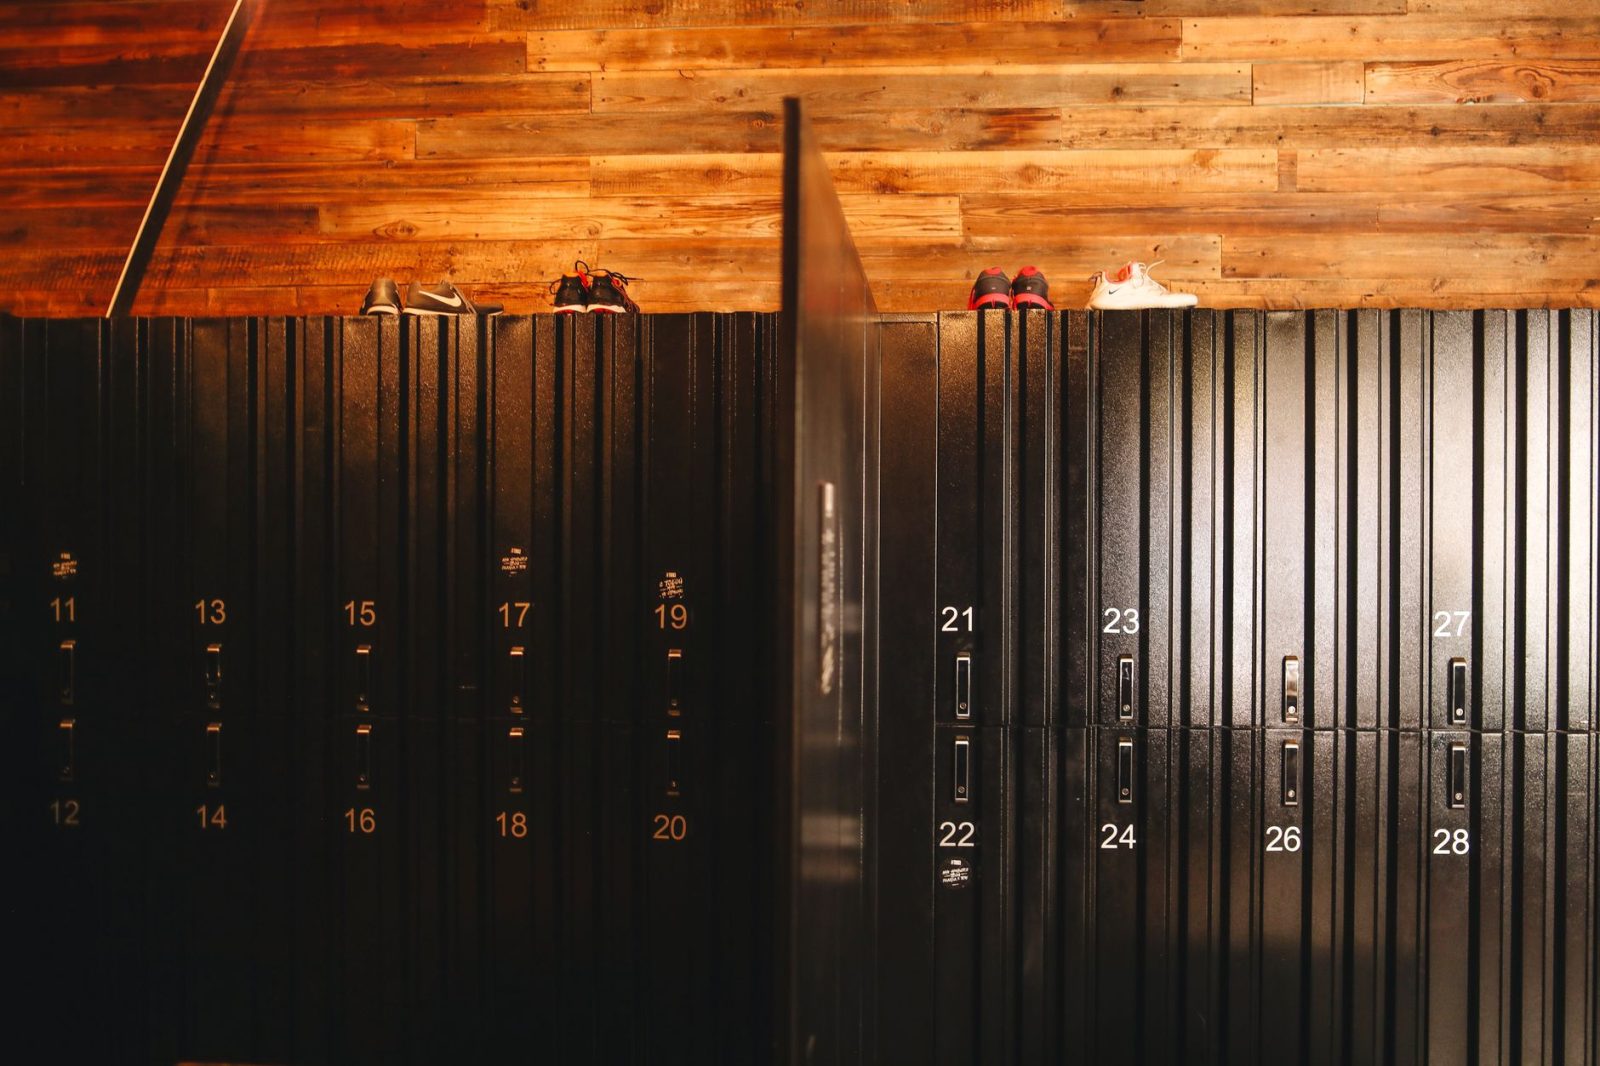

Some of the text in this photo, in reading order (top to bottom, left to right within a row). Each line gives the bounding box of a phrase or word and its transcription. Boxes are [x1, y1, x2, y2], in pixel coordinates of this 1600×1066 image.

[50, 597, 75, 622] 11
[195, 599, 226, 625] 13
[344, 601, 376, 627] 15
[498, 602, 530, 628] 17
[654, 604, 688, 630] 19
[941, 607, 973, 632] 21
[1104, 608, 1140, 635] 23
[1434, 611, 1470, 637] 27
[51, 800, 80, 825] 12
[197, 804, 227, 829] 14
[344, 808, 376, 833] 16
[496, 812, 528, 838] 18
[653, 815, 687, 840] 20
[940, 822, 975, 847] 22
[1101, 824, 1137, 850] 24
[1266, 826, 1301, 852] 26
[1433, 829, 1470, 855] 28
